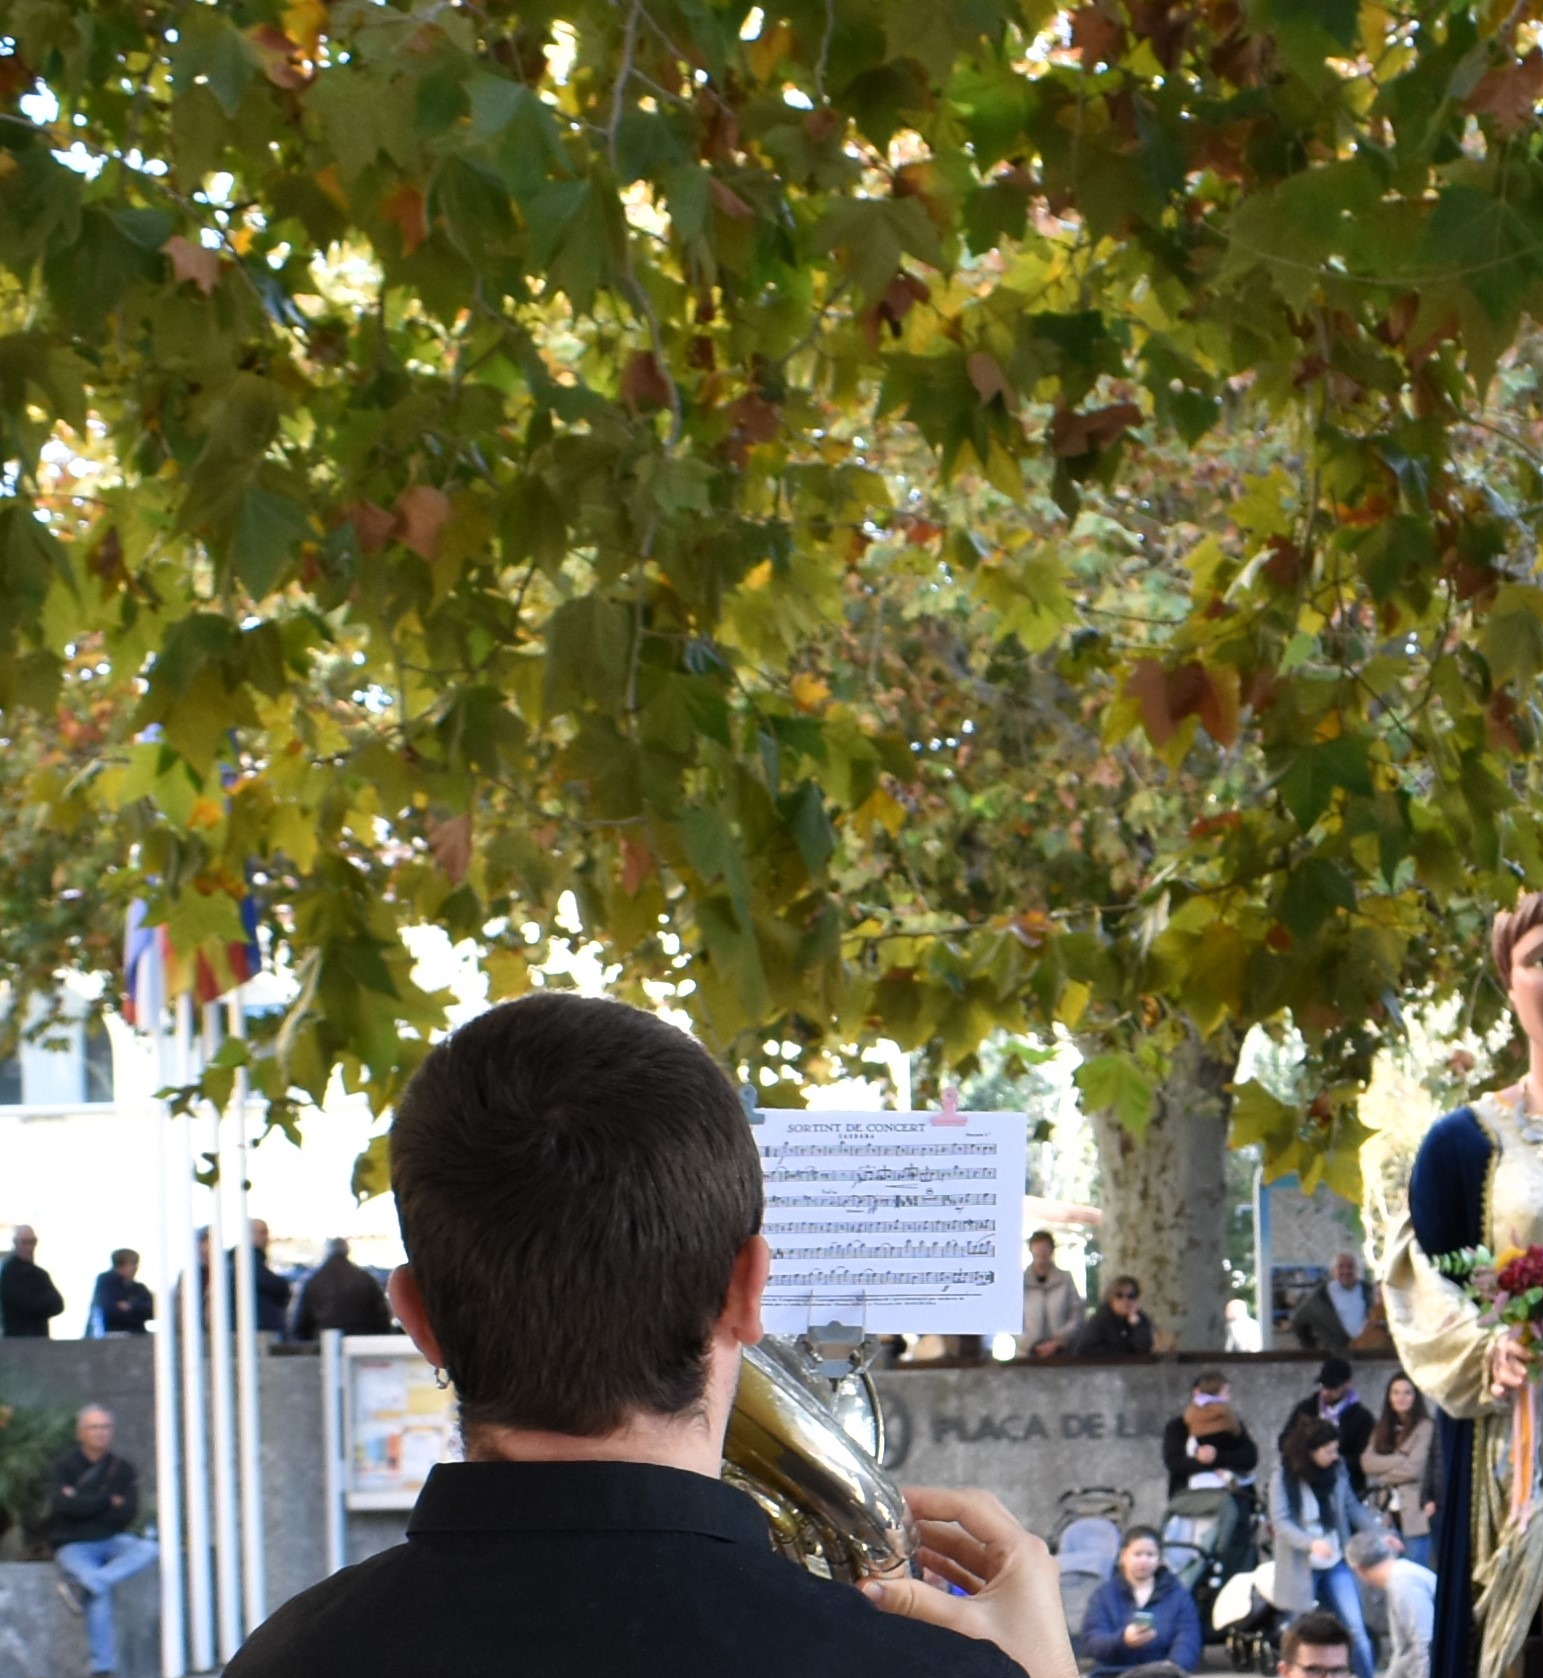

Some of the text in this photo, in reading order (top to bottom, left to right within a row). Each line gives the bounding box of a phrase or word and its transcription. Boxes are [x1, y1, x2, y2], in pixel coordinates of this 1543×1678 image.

[787, 1123, 926, 1133] SORTINT DE CONCERT
[1061, 1412, 1104, 1440] DE
